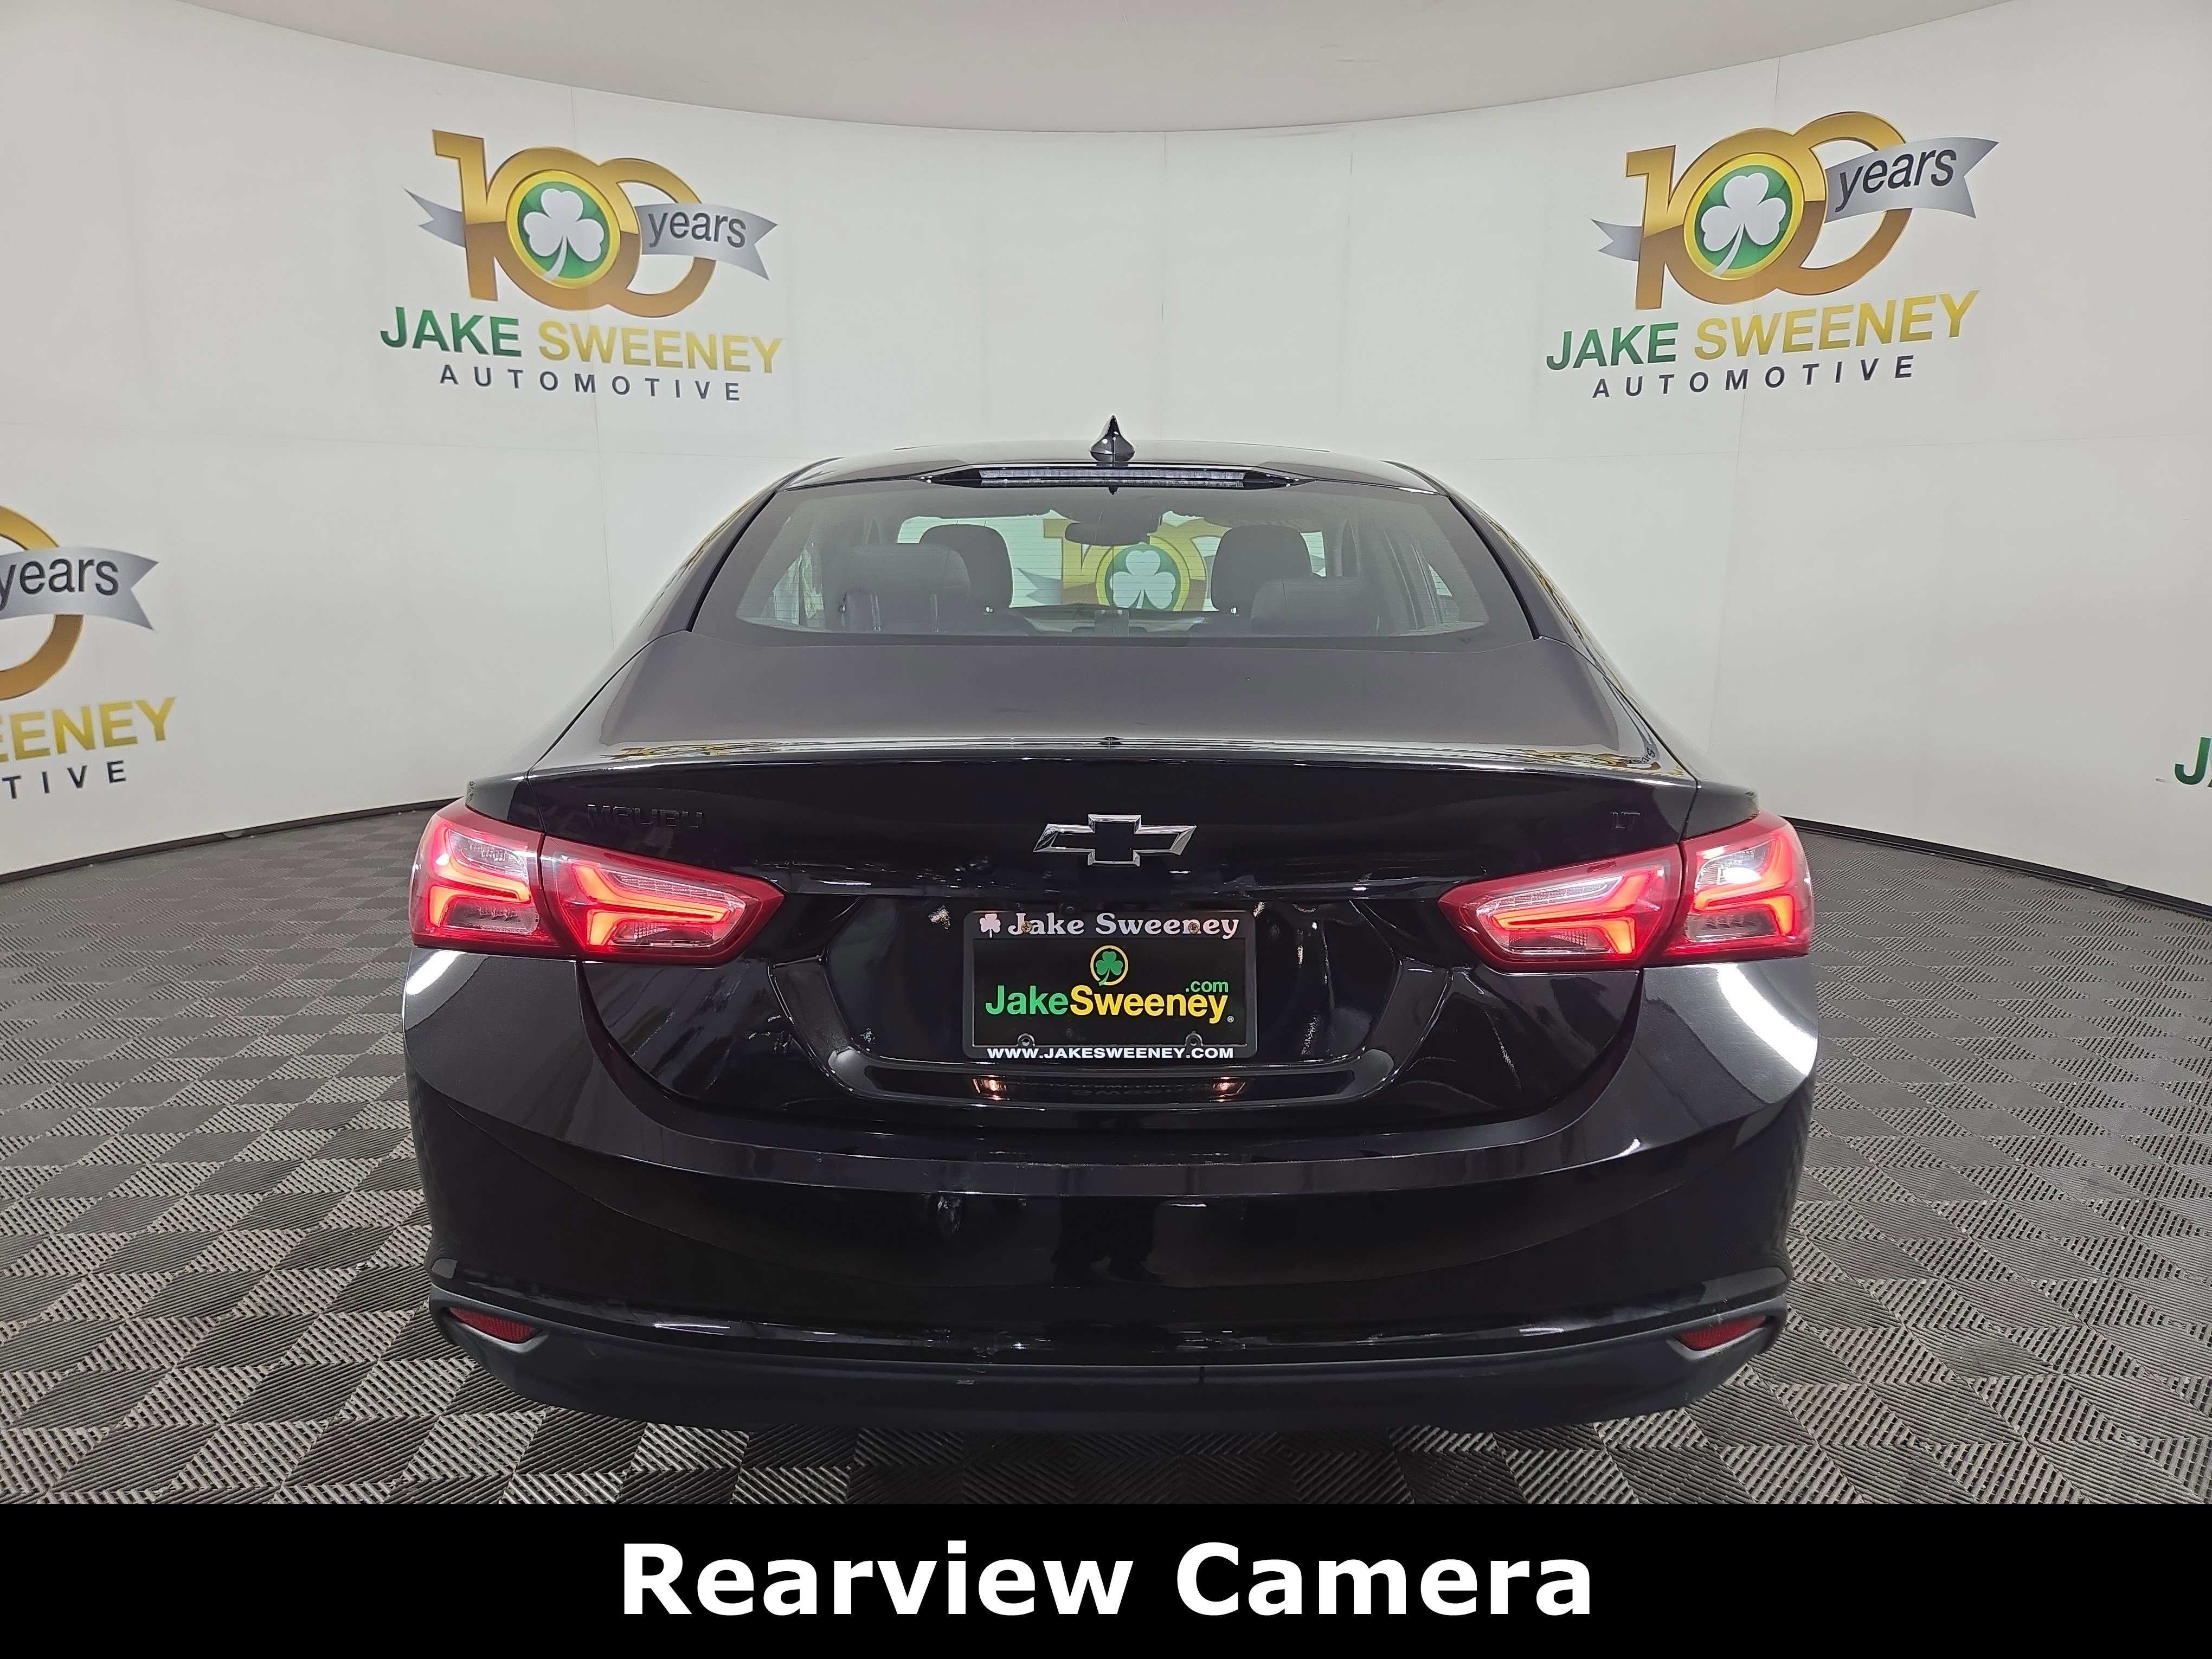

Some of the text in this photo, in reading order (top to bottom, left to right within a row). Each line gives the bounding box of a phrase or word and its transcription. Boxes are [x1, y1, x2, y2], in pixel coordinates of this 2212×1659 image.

[1835, 148, 1957, 213] years
[432, 129, 716, 317] 100
[647, 209, 748, 248] years
[1626, 111, 1914, 310] 100
[380, 306, 783, 374] JAKE SWEENEY
[1546, 289, 1980, 370] JAKE SWEENEY
[440, 364, 741, 401] AUTOMOTIVE
[1592, 355, 1914, 398] AUTOMOTIVE
[0, 697, 176, 762] ENEY
[1008, 912, 1239, 939] Jake Sweeney
[1186, 981, 1229, 993] .com
[987, 1047, 1234, 1058] WWW.JAKESWEENEY.COM
